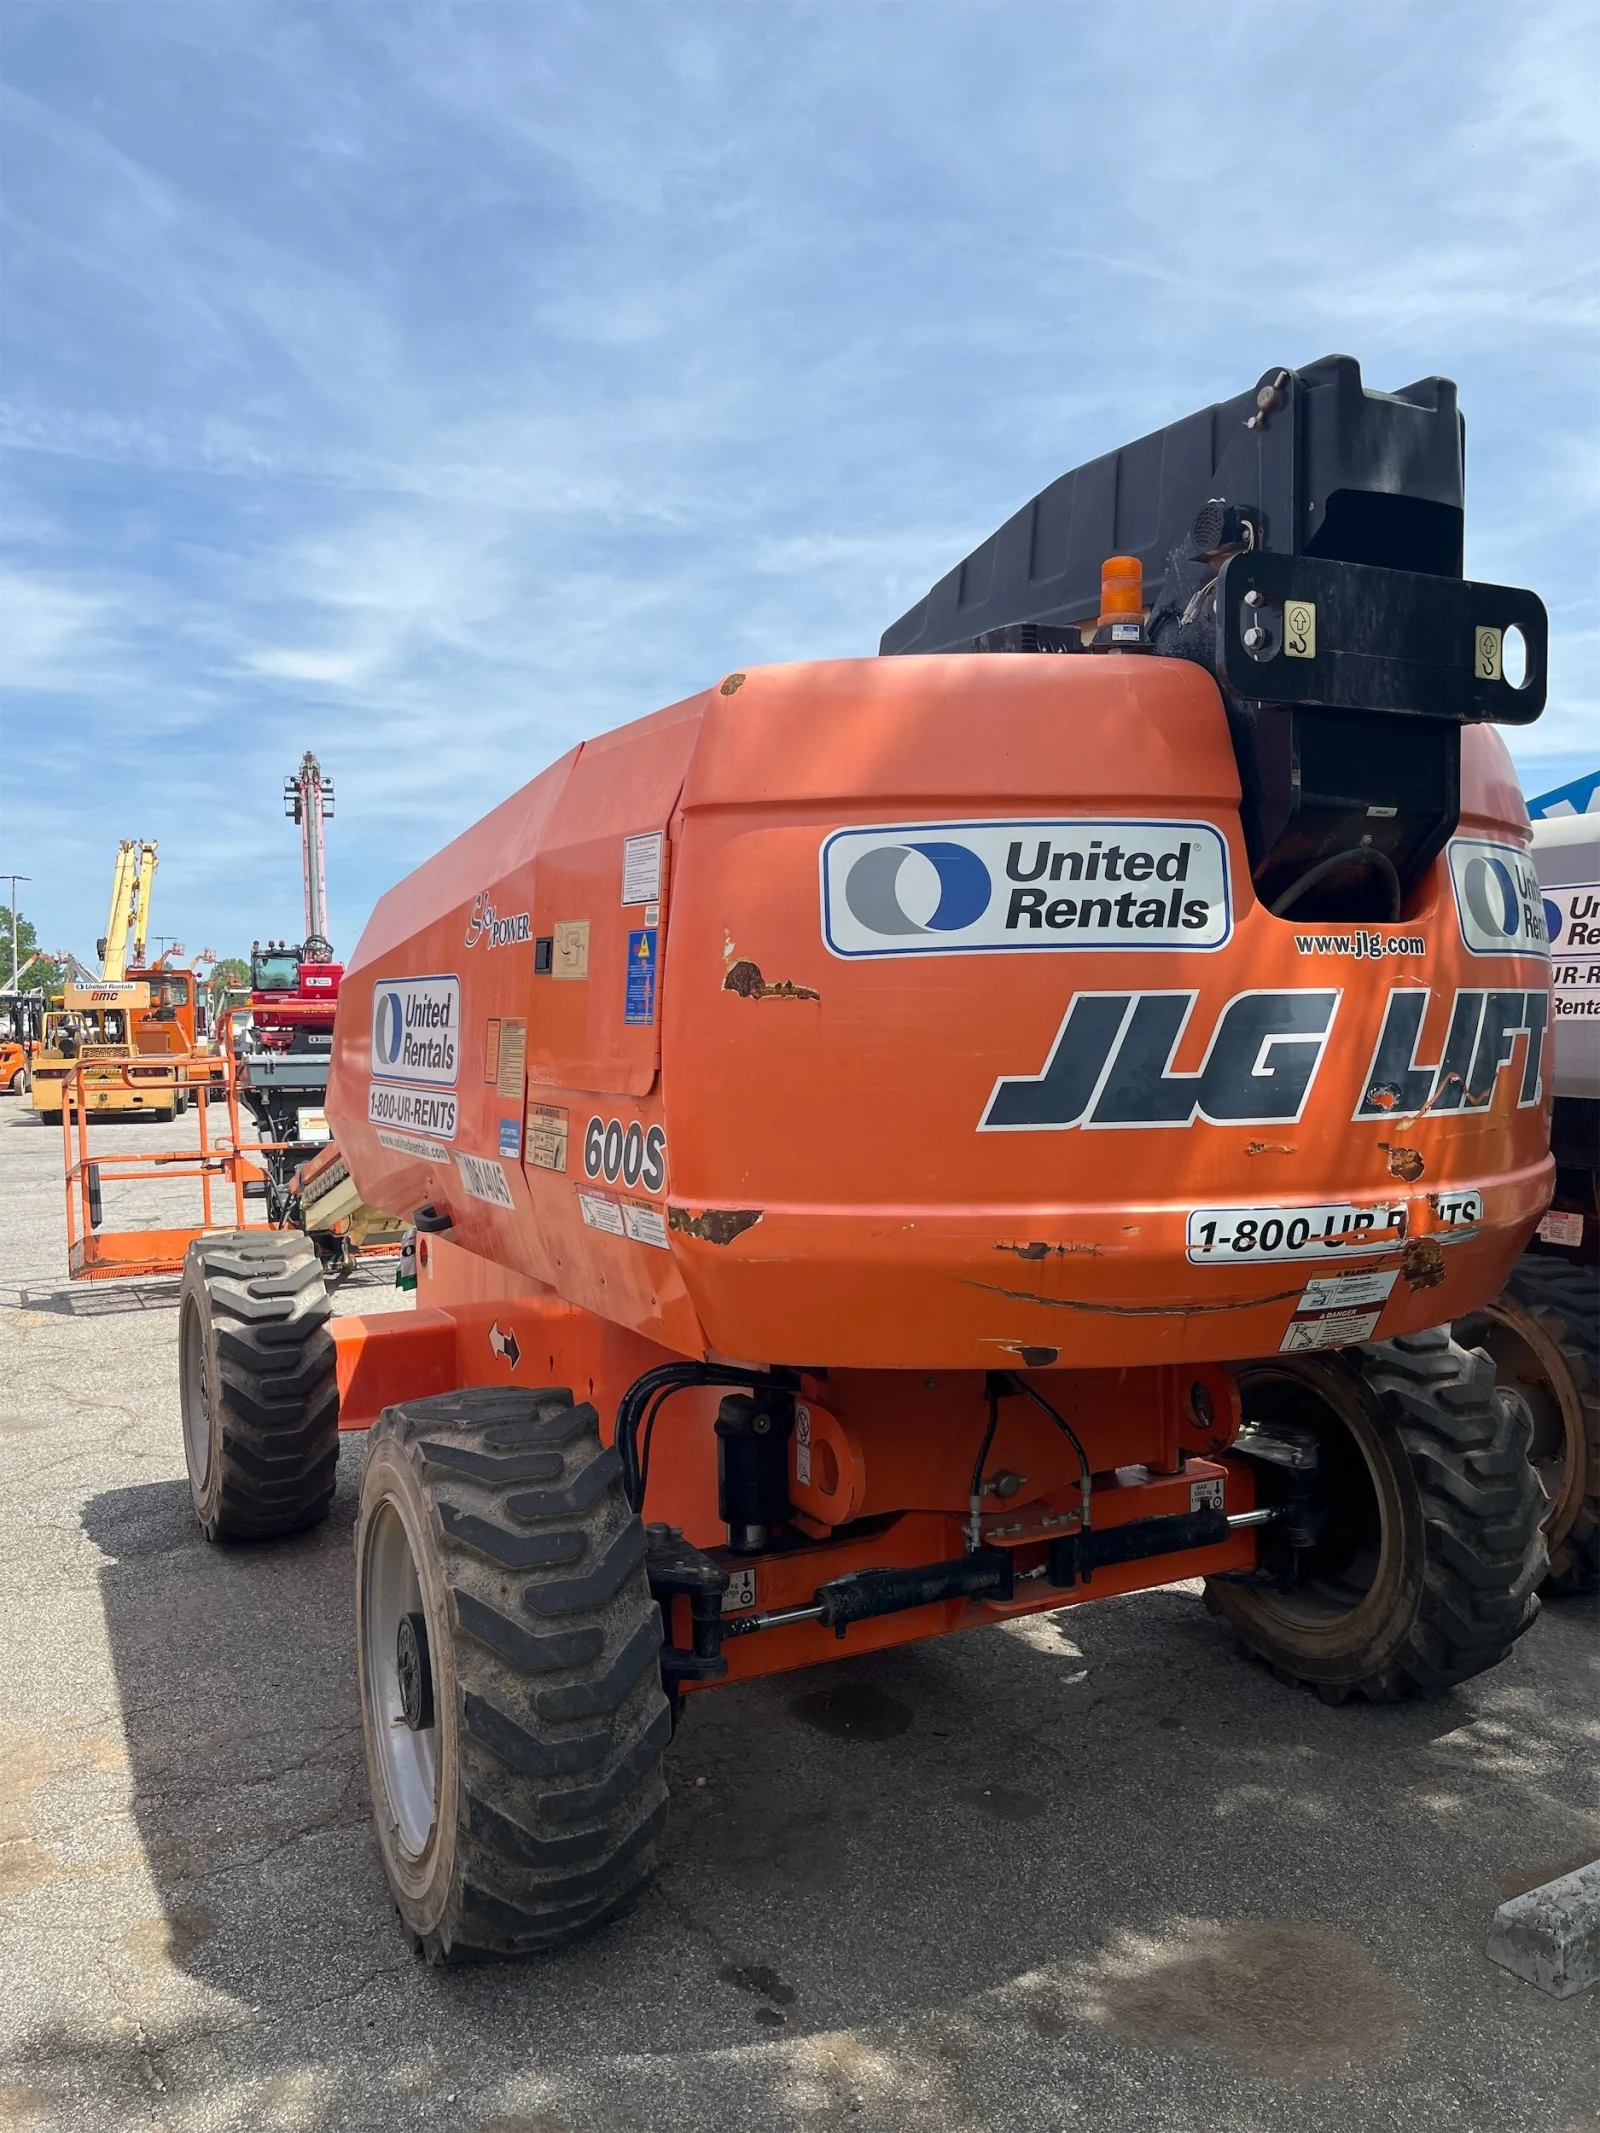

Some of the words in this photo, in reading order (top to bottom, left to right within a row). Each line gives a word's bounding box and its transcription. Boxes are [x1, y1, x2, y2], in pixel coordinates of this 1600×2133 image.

[1006, 841, 1191, 882] United
[1005, 888, 1210, 929] Rentals
[1295, 931, 1425, 959] www.jlg.com
[405, 993, 451, 1028] United
[403, 1033, 454, 1070] Rentals
[975, 988, 1344, 1132] JLG
[371, 1092, 455, 1131] 1-800-UR-RENTS
[585, 1116, 667, 1193] 600S
[1326, 1309, 1357, 1318] DANGER
